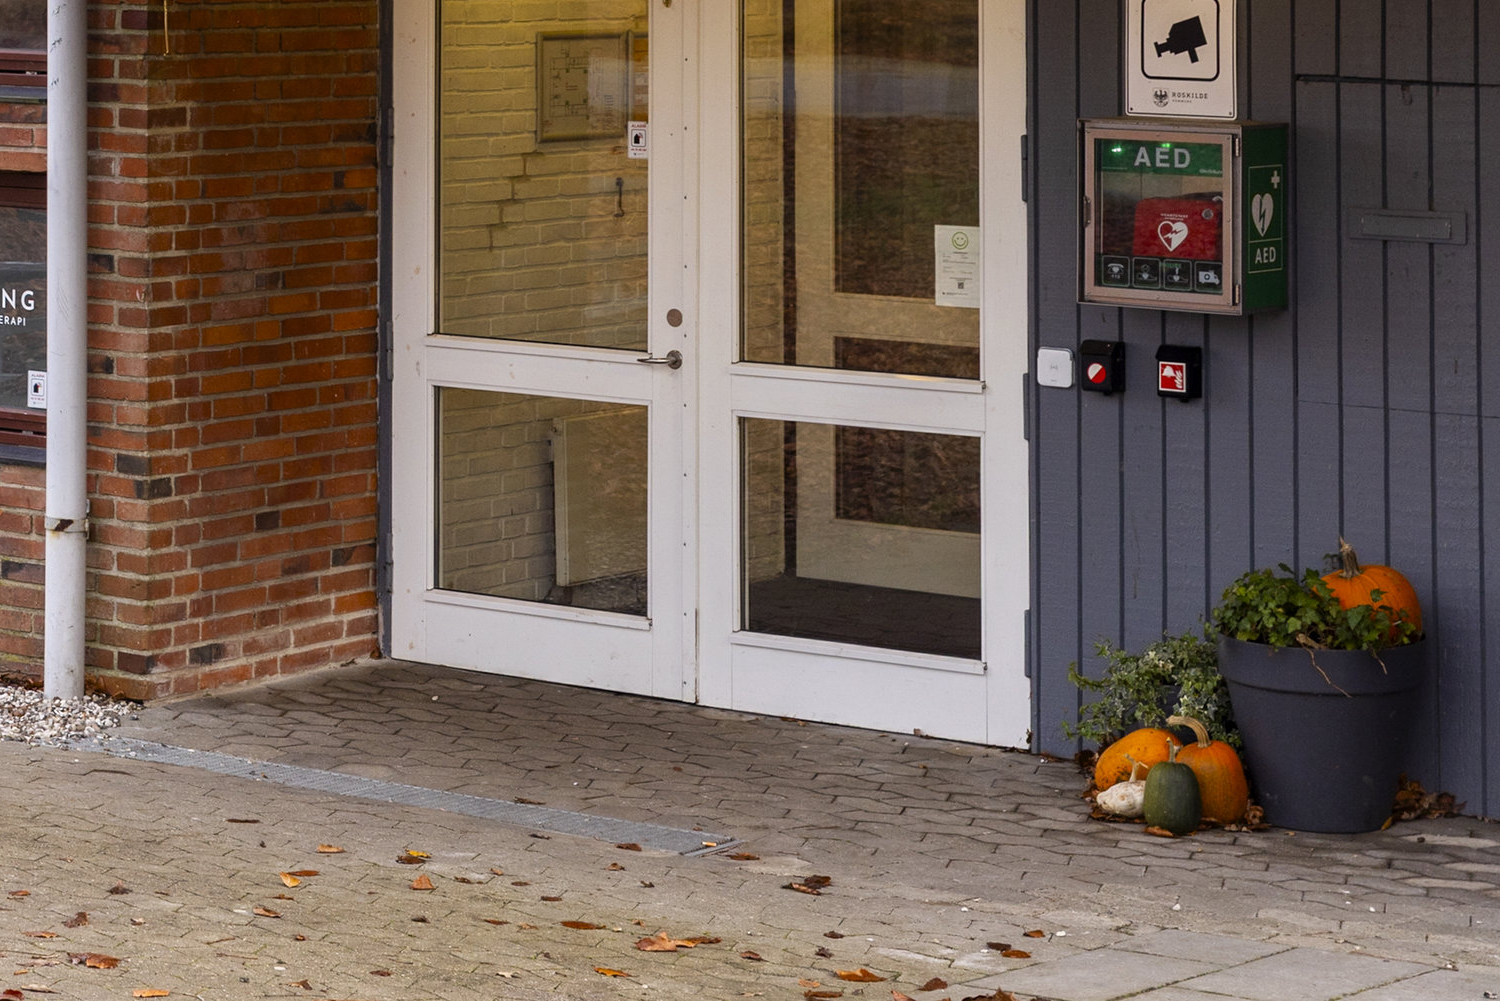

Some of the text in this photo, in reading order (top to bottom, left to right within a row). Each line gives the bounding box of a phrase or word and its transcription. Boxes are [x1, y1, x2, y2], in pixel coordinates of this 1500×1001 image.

[1171, 91, 1209, 100] ROSKILDE
[1133, 146, 1192, 169] AED
[1254, 246, 1277, 265] AED
